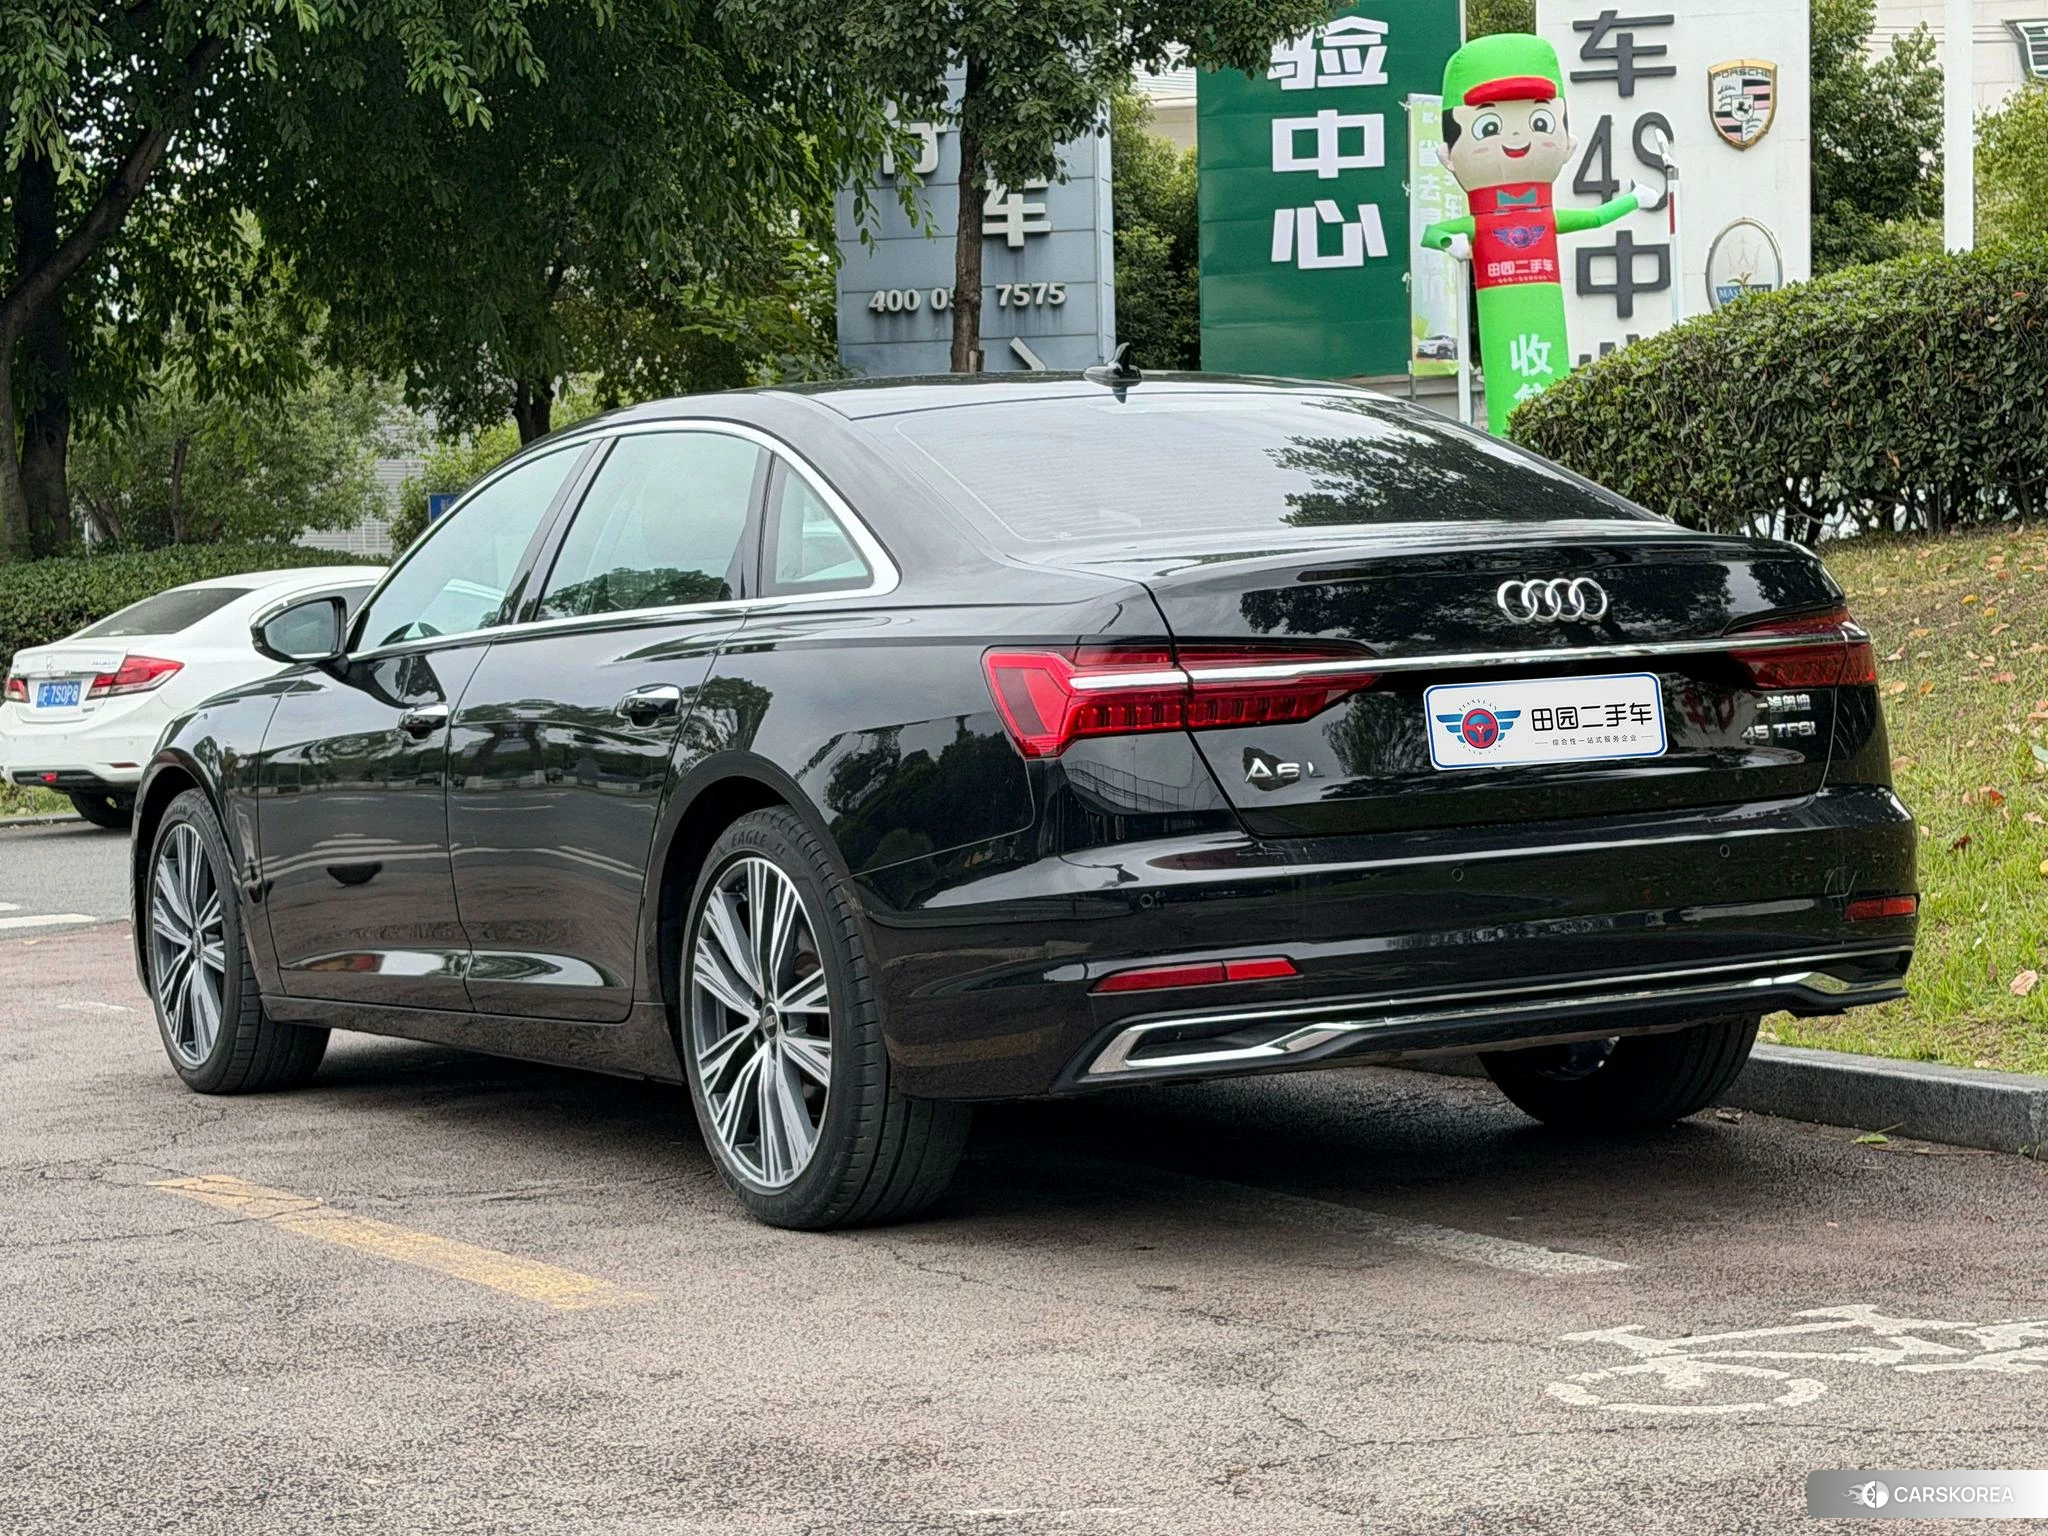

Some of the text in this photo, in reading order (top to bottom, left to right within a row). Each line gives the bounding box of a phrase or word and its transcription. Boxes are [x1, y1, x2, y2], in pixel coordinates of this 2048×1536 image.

[1267, 16, 1388, 269] 验中心
[868, 289, 921, 313] 400
[996, 282, 1067, 307] 7575
[1531, 703, 1653, 731] 田园二手车
[1742, 721, 1816, 739] 45 TFSI
[731, 830, 768, 848] EAGLE
